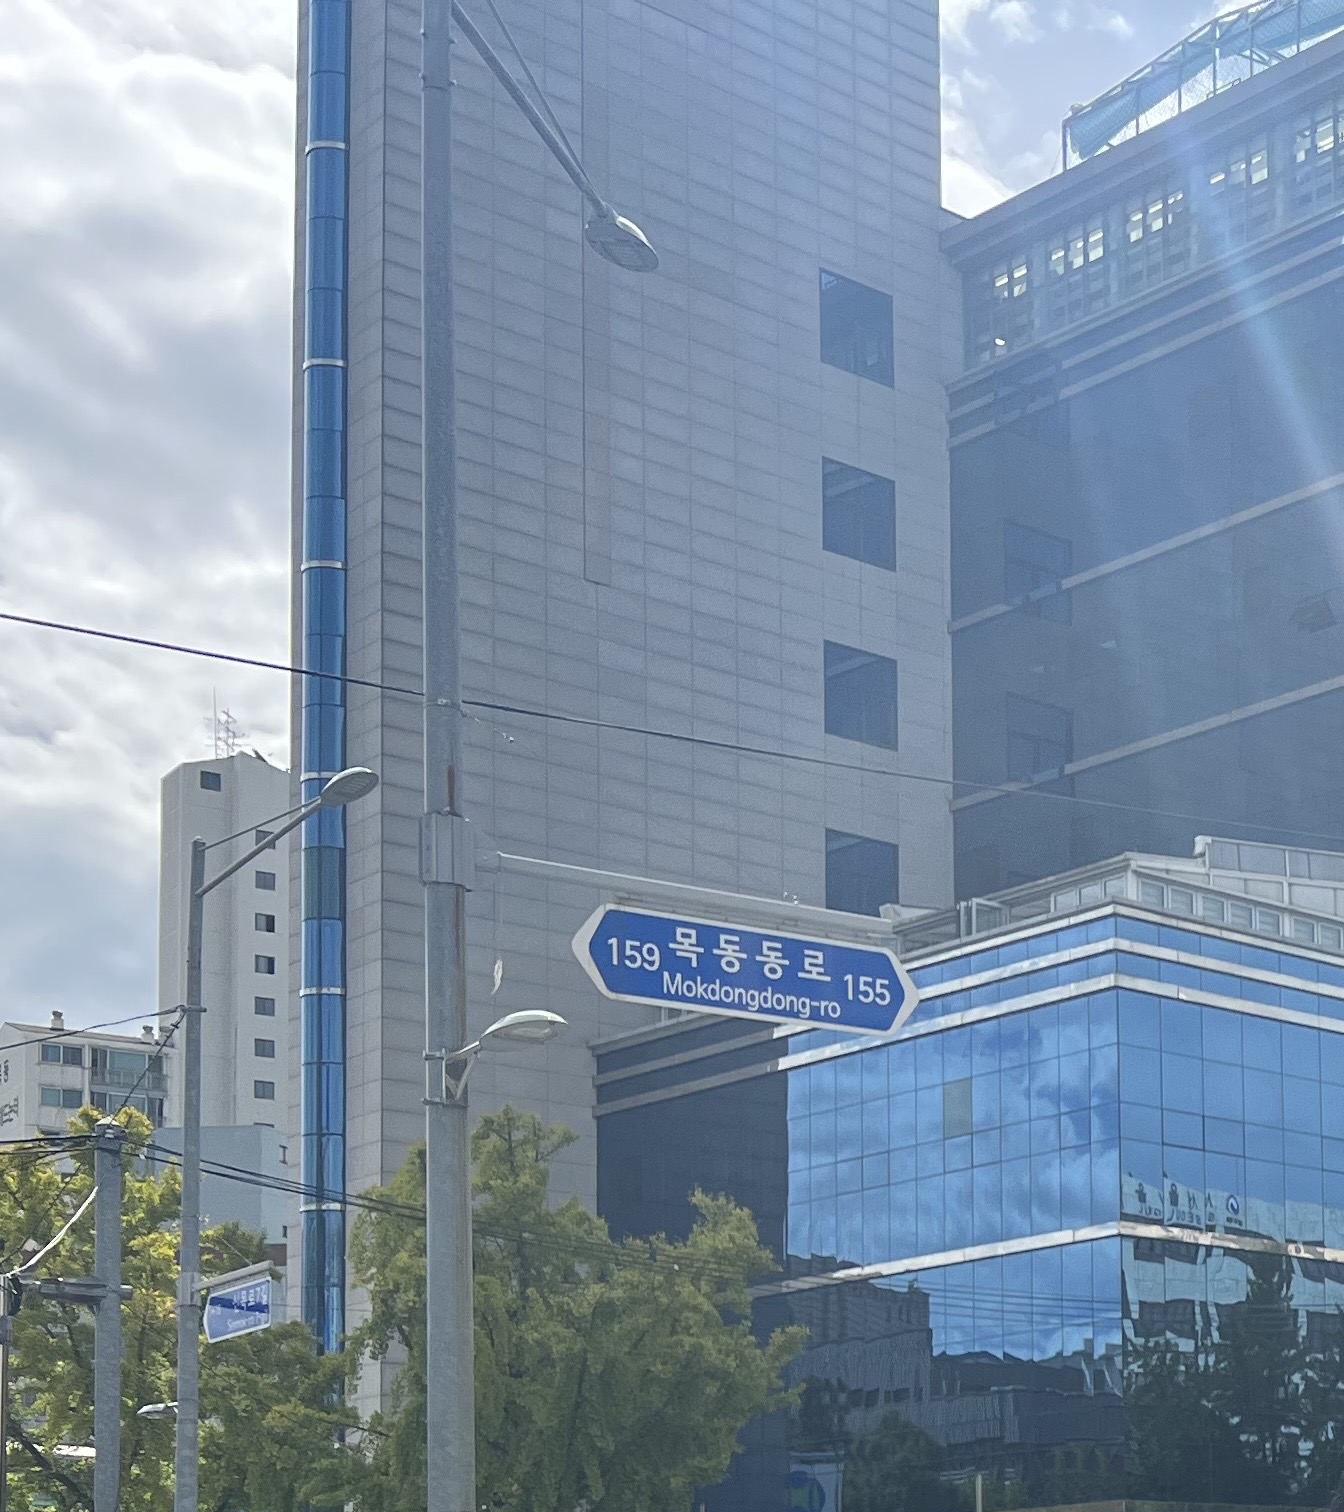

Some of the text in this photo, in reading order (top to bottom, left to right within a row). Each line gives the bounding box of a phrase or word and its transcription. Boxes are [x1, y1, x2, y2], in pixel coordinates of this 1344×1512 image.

[607, 927, 890, 1005] 159 목동동로 155
[663, 972, 841, 1018] Mokdongdong-ro
